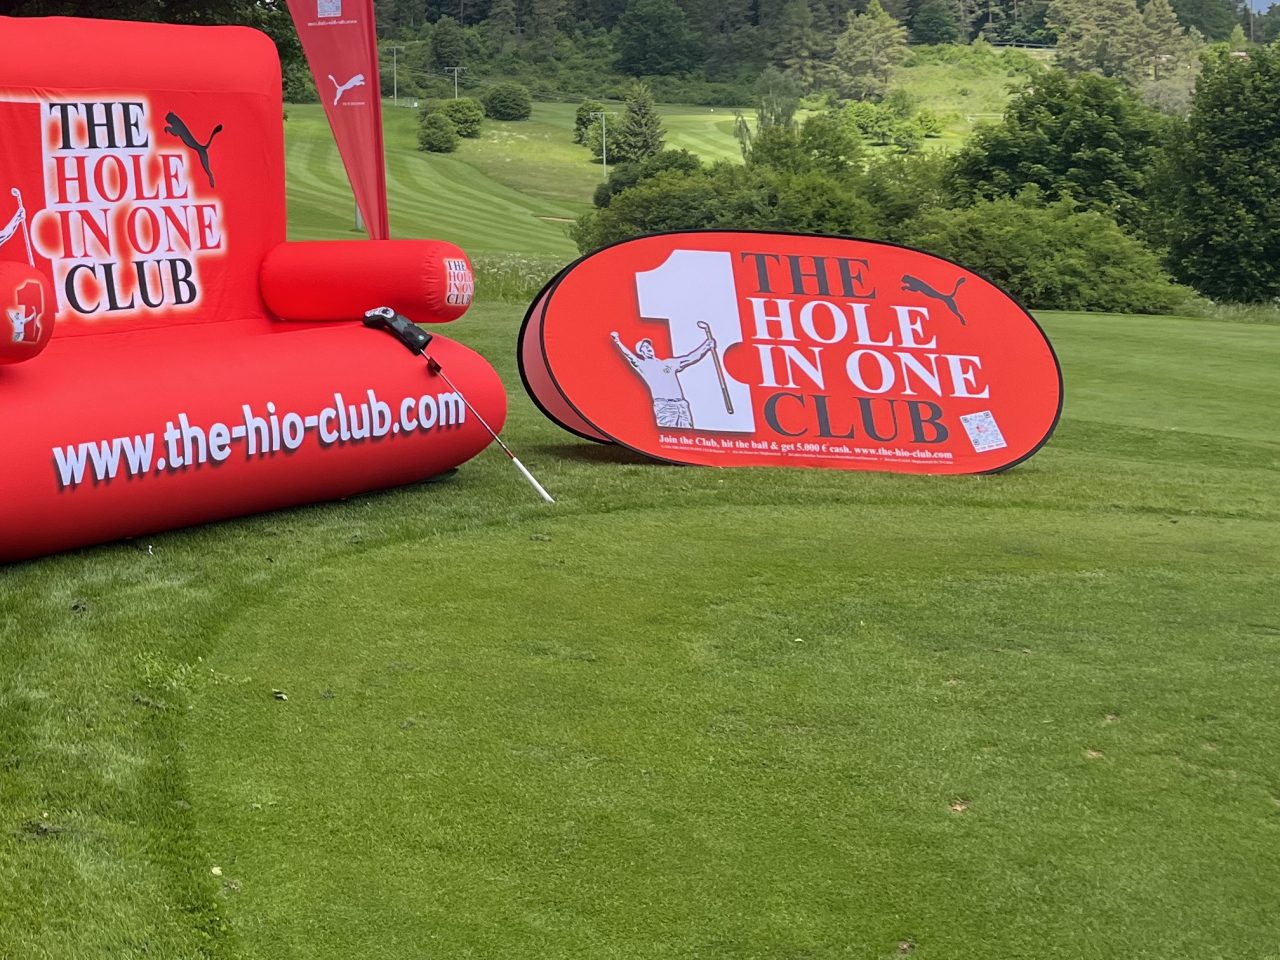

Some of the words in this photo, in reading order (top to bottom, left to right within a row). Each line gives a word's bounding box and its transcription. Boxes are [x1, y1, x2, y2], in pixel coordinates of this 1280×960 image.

[49, 102, 149, 150] THE
[51, 154, 188, 204] HOLE
[56, 208, 111, 259] IN
[127, 204, 222, 255] ONE
[64, 258, 197, 314] CLUB
[741, 252, 876, 299] THE
[746, 297, 937, 349] HOLE
[752, 344, 825, 390] IN
[846, 349, 990, 399] ONE
[52, 389, 466, 486] www.the-hio-club.com
[764, 392, 949, 444] CLUB
[659, 435, 678, 444] Join
[680, 437, 693, 445] the
[721, 439, 733, 448] hit
[736, 440, 750, 449] the
[751, 441, 768, 449] ball
[770, 442, 778, 450] &
[780, 442, 795, 452] get
[829, 445, 852, 453] cash.
[854, 448, 953, 459] www.the-hio-club.com
